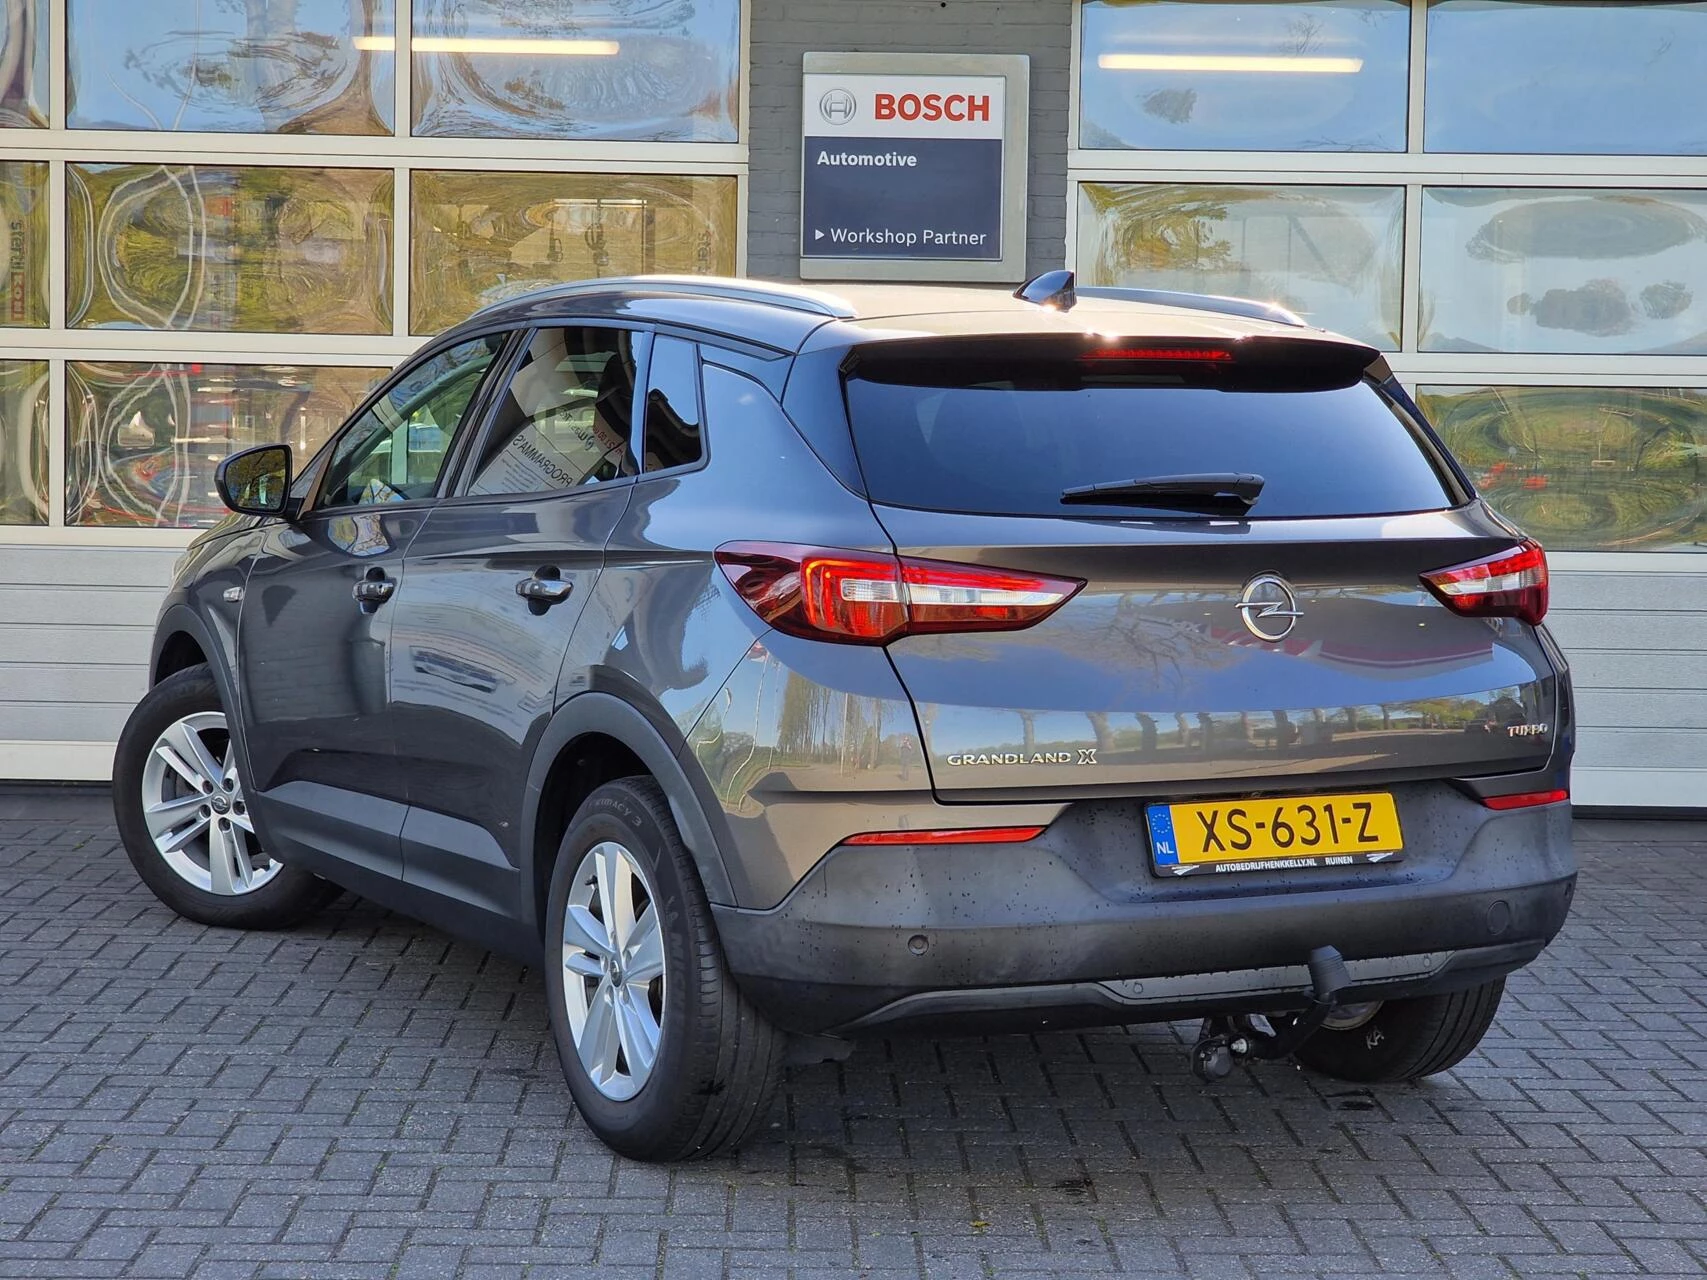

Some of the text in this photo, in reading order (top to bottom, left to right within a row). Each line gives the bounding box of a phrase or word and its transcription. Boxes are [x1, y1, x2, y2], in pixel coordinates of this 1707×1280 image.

[875, 93, 990, 122] BOSCH
[817, 150, 917, 167] Automotive
[830, 228, 987, 247] Workshop Partner
[947, 749, 1097, 766] GRANDLAND X
[1196, 802, 1379, 853] XS-631-Z
[1156, 841, 1174, 855] NL
[1215, 856, 1353, 873] AUTOBEDRIJFHENKKELLY.NL RUINEN
